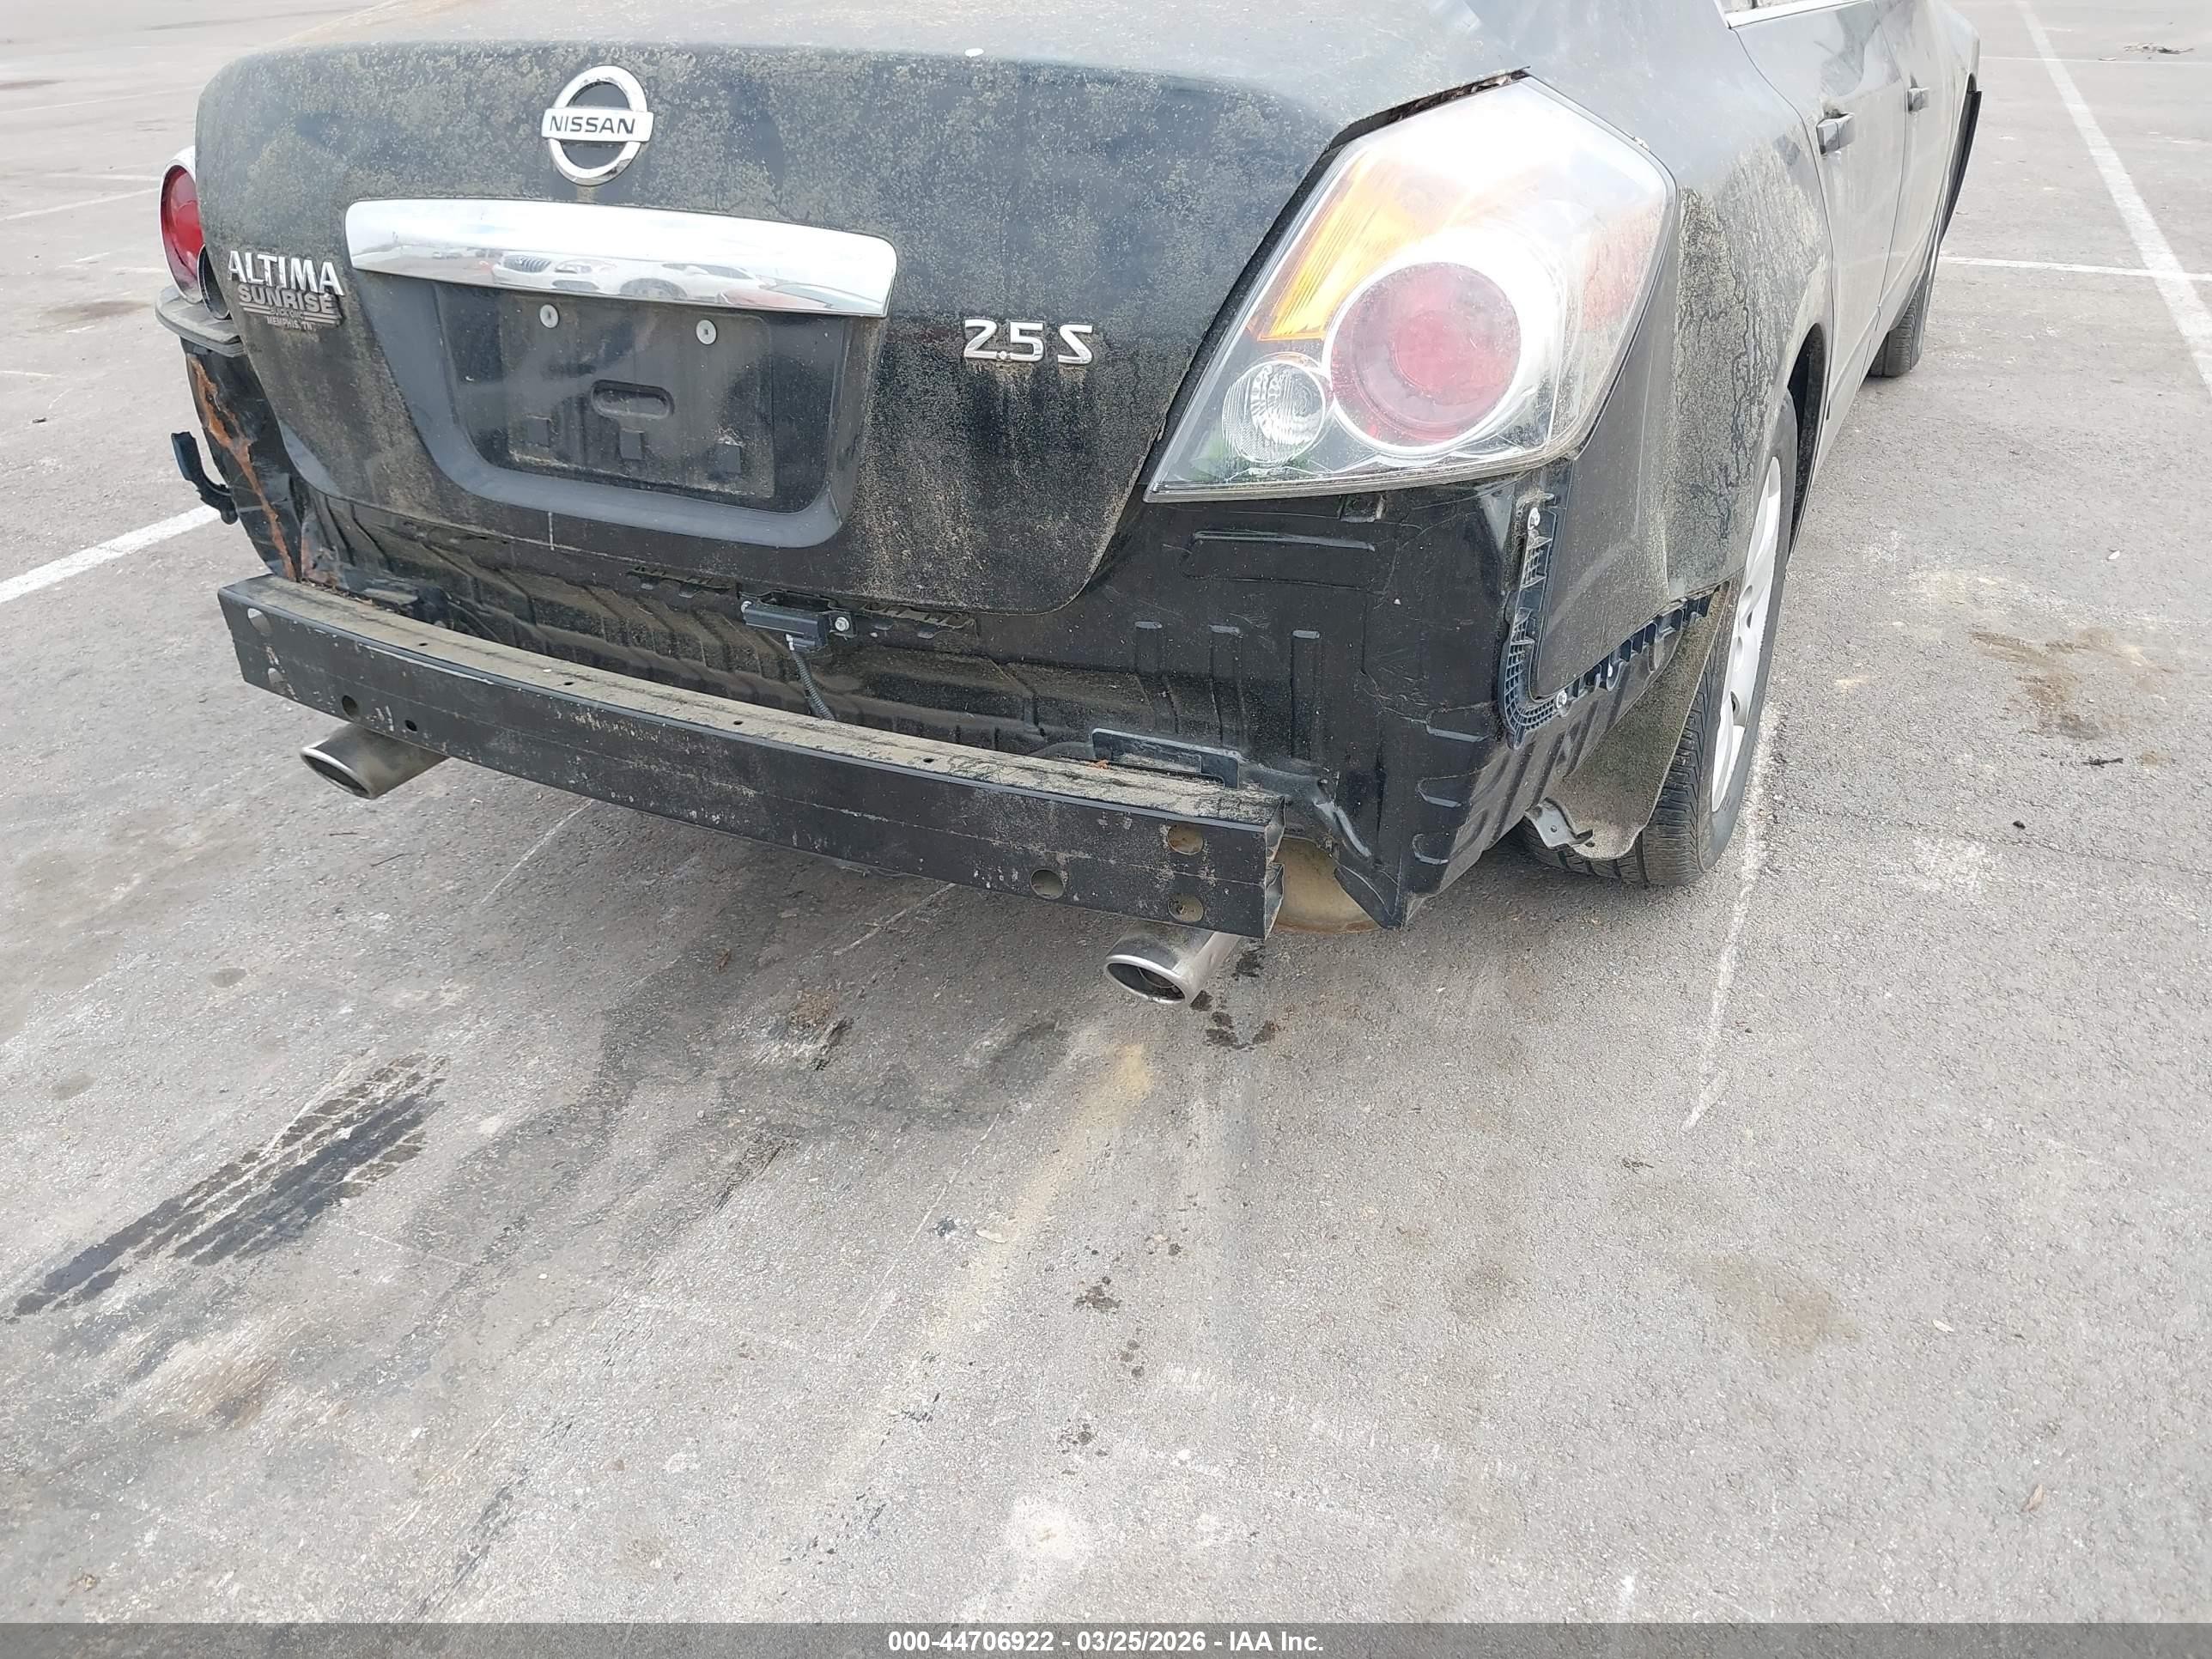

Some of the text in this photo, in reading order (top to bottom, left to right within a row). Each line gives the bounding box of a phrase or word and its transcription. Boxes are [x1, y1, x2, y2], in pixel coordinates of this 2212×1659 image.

[549, 114, 635, 135] NISSAN
[227, 250, 345, 296] ALTIMA
[238, 283, 337, 314] SUNRISE
[963, 319, 1094, 365] 2.5 S
